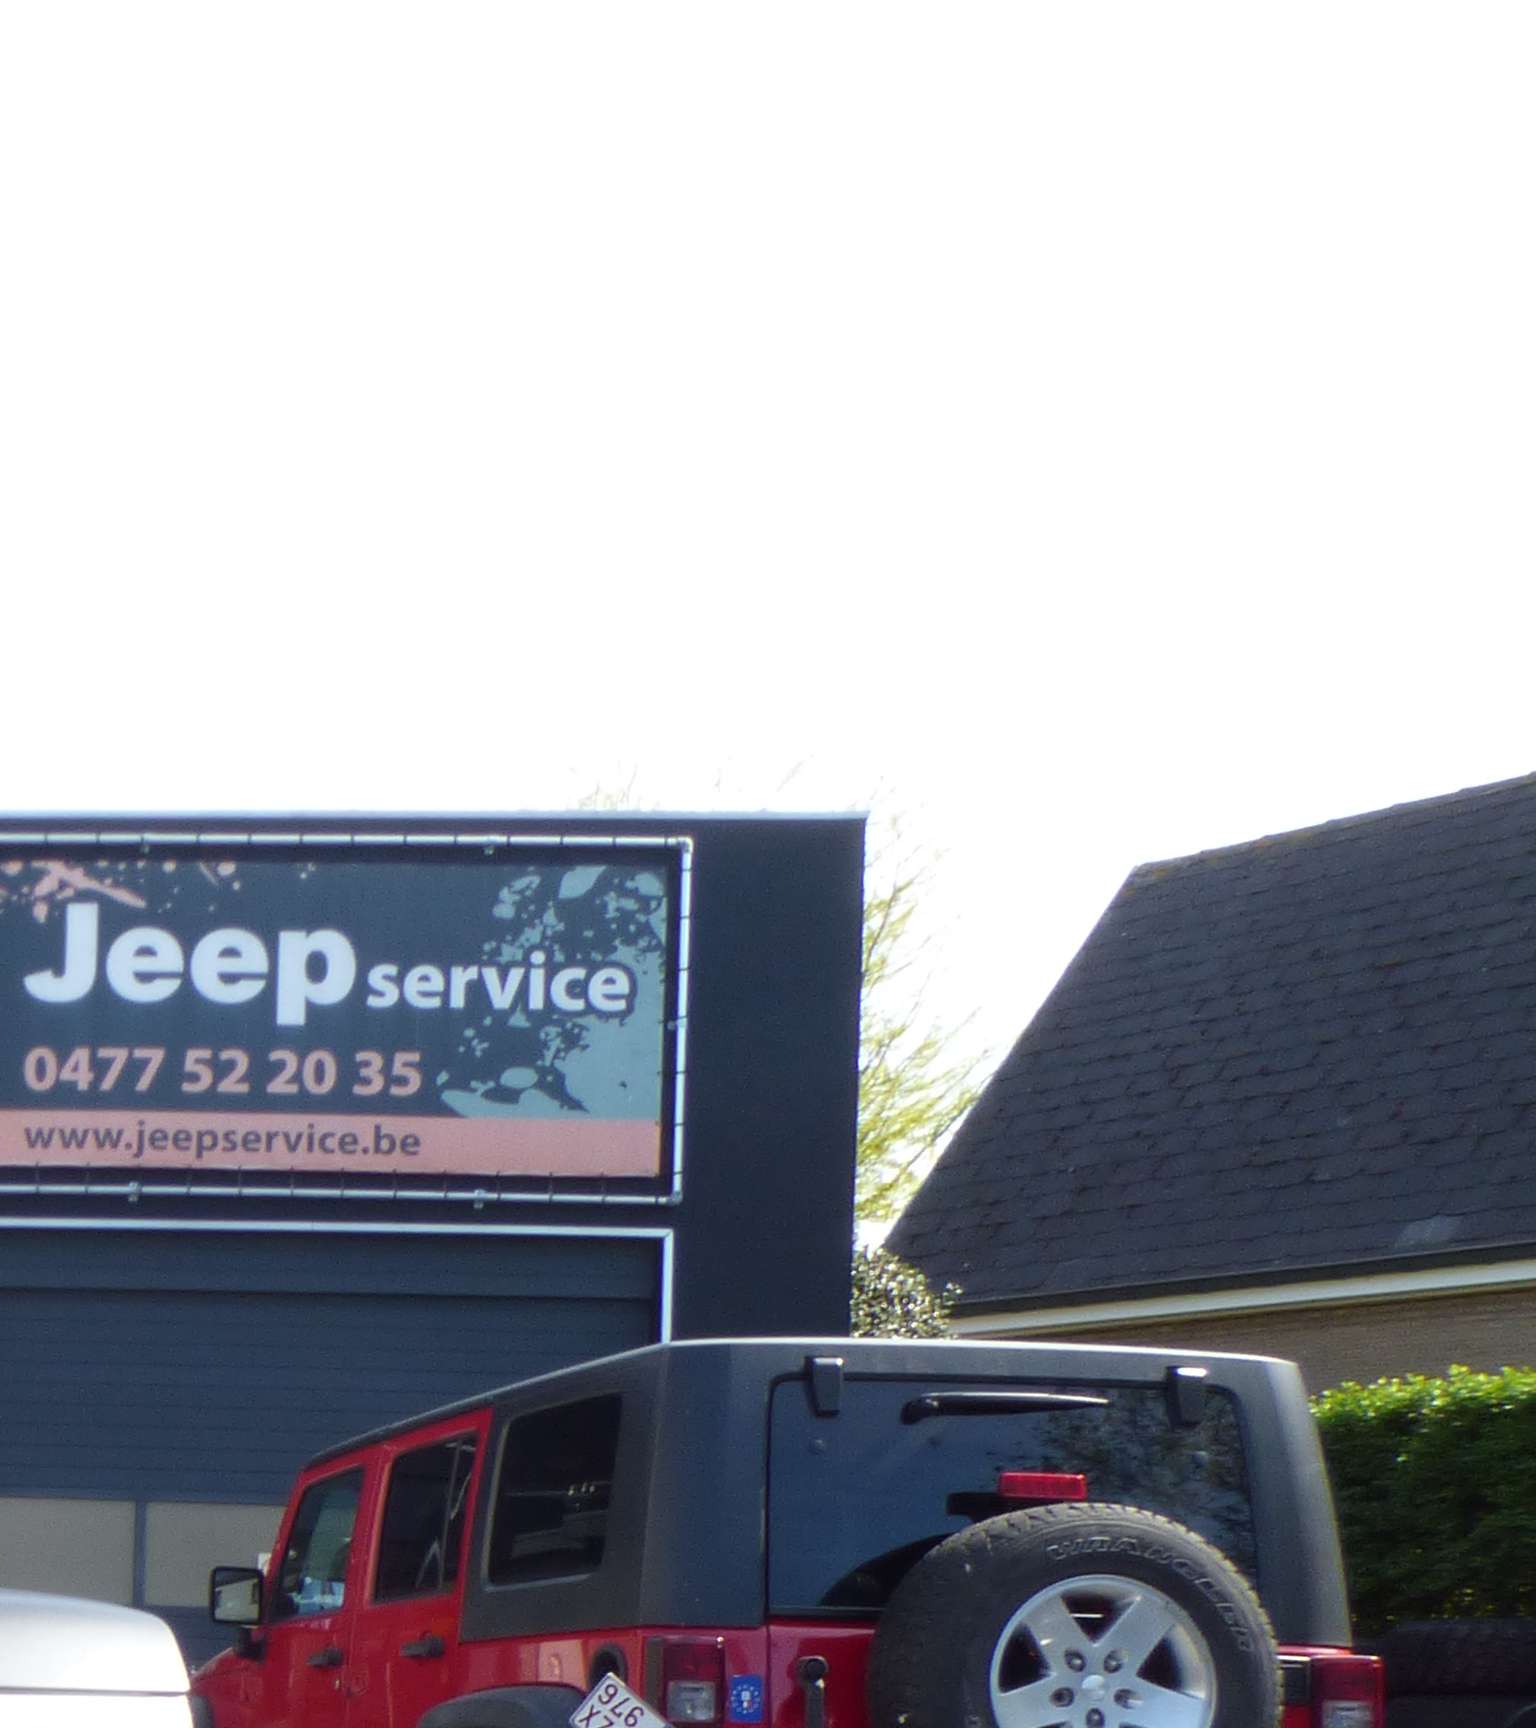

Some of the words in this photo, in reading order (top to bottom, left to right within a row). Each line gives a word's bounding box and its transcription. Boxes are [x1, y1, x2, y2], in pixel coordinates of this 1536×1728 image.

[23, 902, 357, 1026] Jeep
[366, 951, 630, 1012] service
[23, 1046, 166, 1093] 0477
[180, 1049, 251, 1094] 52
[266, 1049, 338, 1095] 20
[352, 1050, 423, 1097] 35
[24, 1119, 422, 1159] www.jeepservice.be
[598, 1684, 644, 1728] 976
